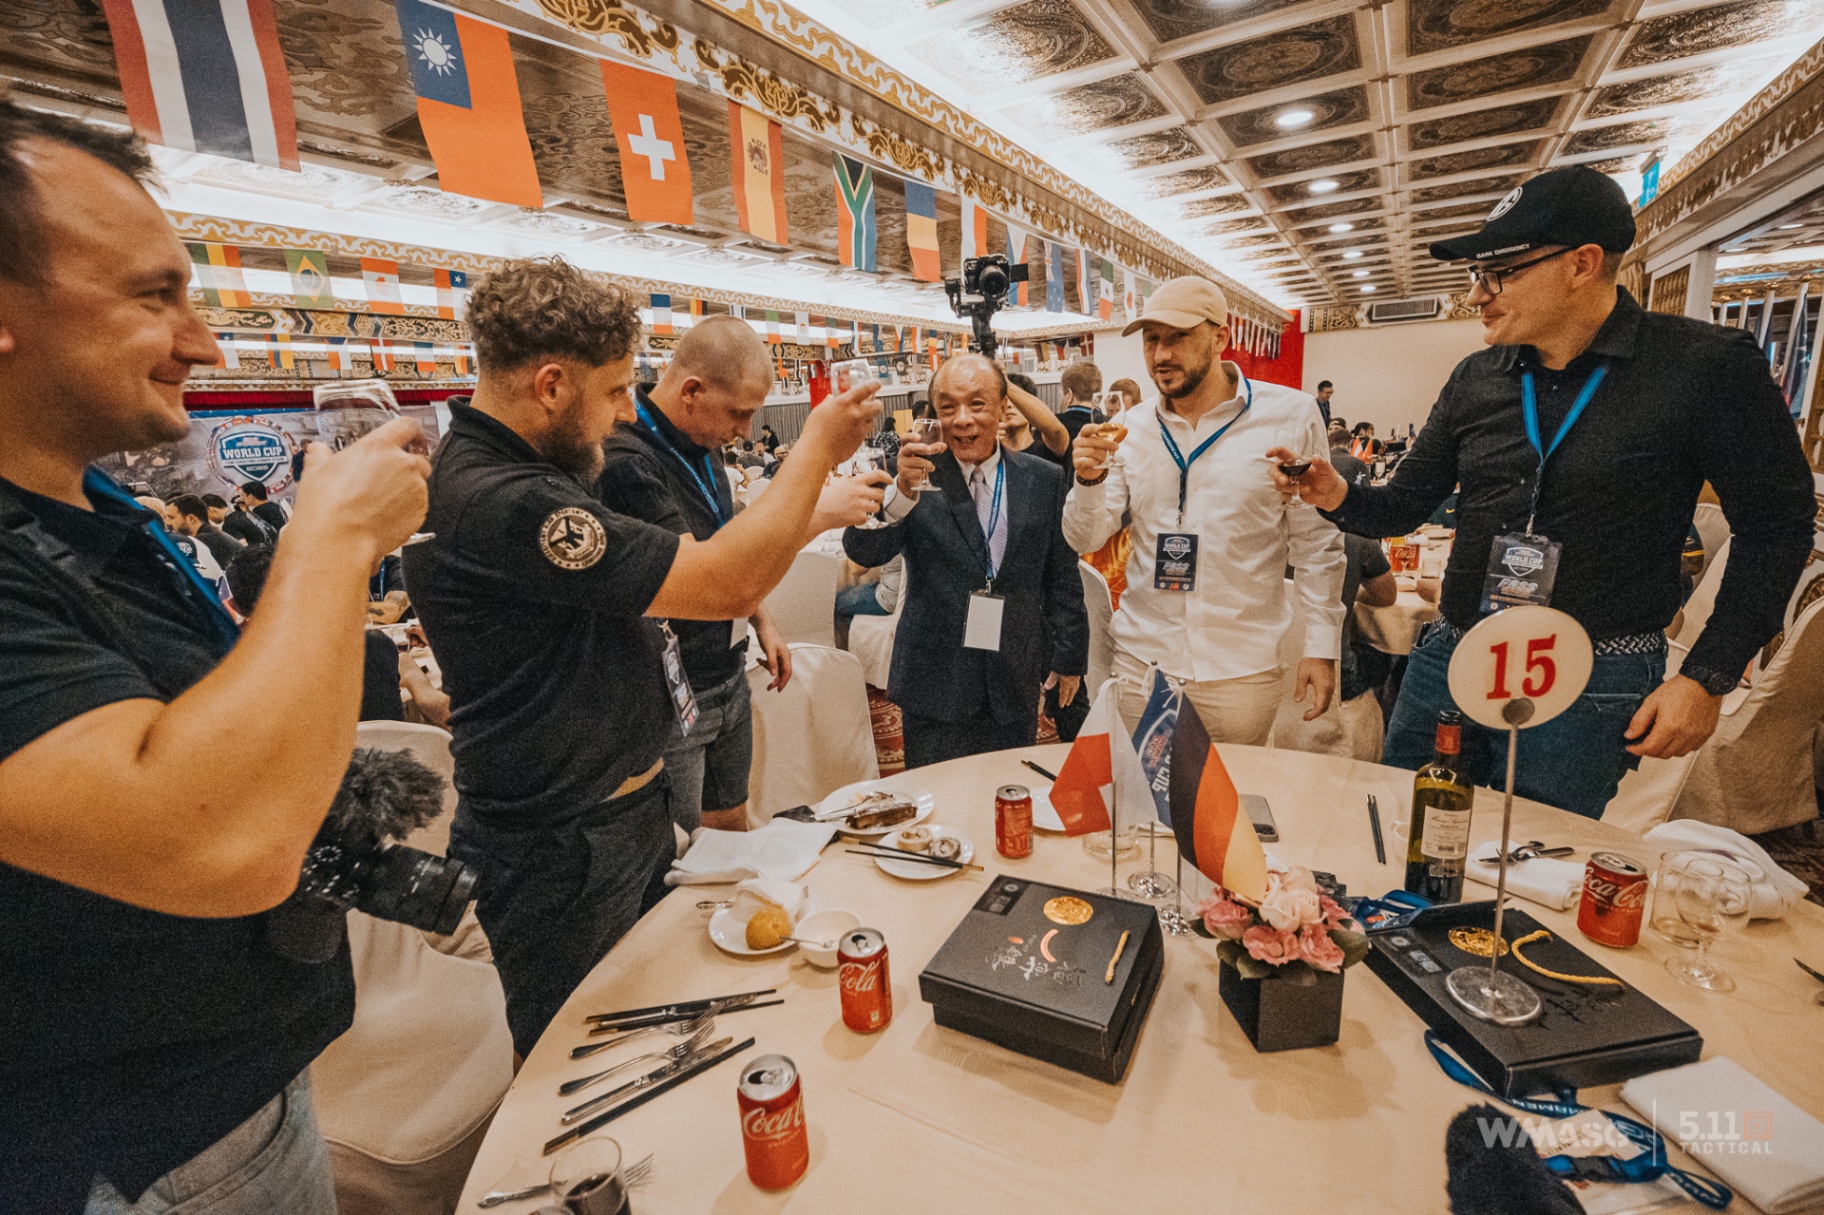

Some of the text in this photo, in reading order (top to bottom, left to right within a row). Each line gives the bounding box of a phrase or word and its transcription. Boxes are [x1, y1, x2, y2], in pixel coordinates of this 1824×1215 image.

[1494, 243, 1530, 256] EMERGENCY
[222, 446, 283, 459] WORLD CUP
[1505, 554, 1529, 563] WORLD
[1529, 557, 1543, 565] CUP
[1486, 633, 1557, 700] 15
